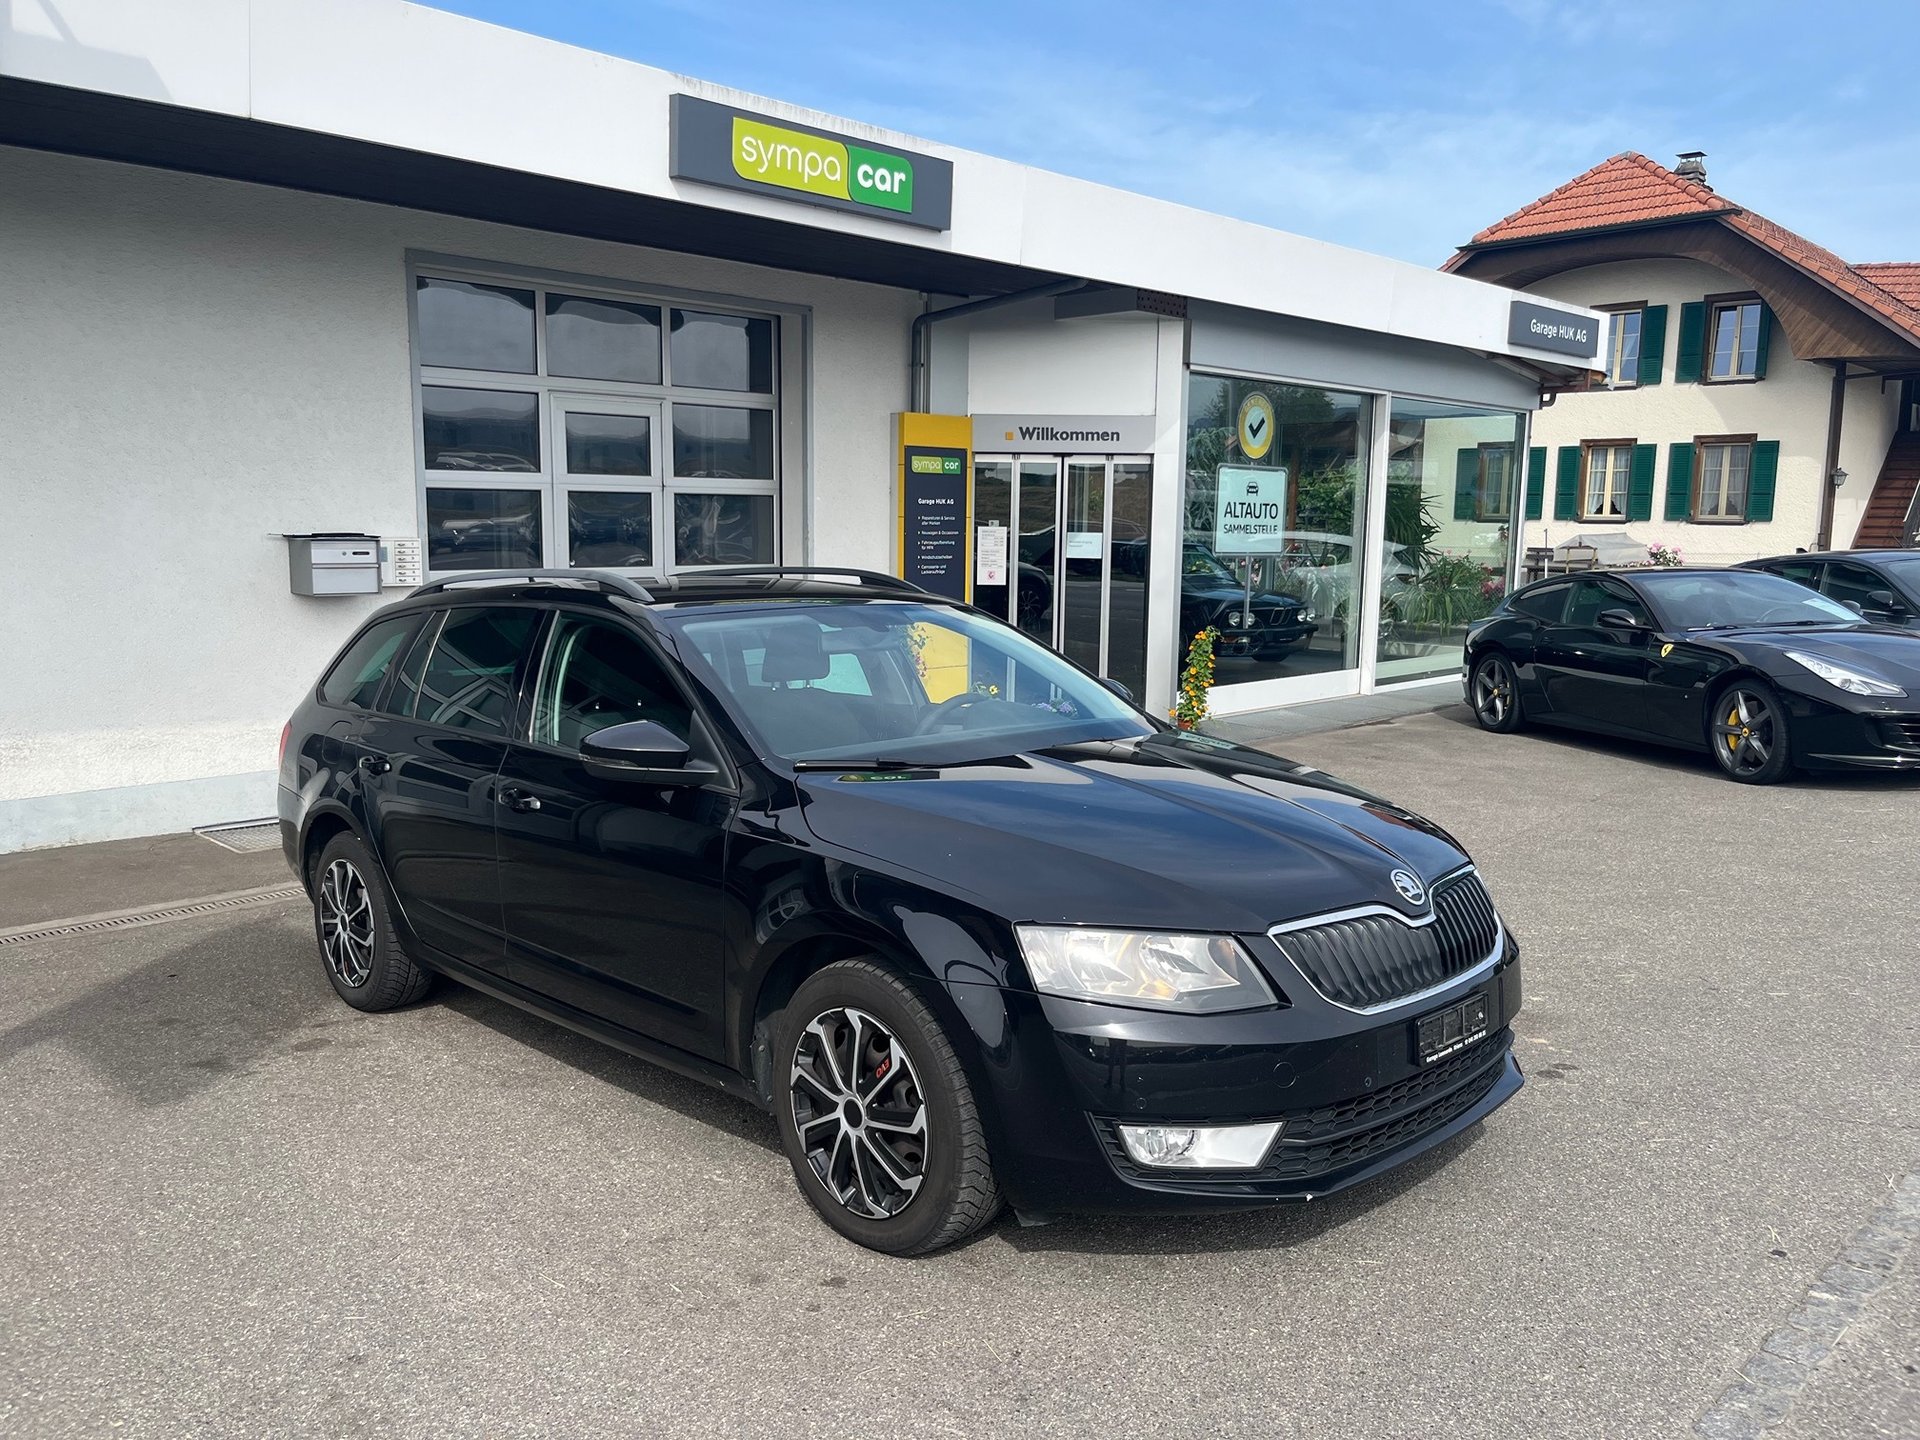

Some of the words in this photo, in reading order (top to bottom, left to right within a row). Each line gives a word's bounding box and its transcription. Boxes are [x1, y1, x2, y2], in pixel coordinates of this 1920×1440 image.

[741, 136, 841, 183] sympa
[857, 164, 906, 194] car
[1530, 319, 1557, 338] Garage
[1558, 325, 1574, 340] HUK
[1575, 329, 1587, 343] AG
[1018, 426, 1120, 442] Willkommen
[913, 460, 941, 471] sympa
[944, 461, 959, 470] car
[1223, 501, 1279, 520] ALTAUTO
[1223, 523, 1278, 535] SAMMELSTELLE
[875, 1058, 890, 1079] EVO
